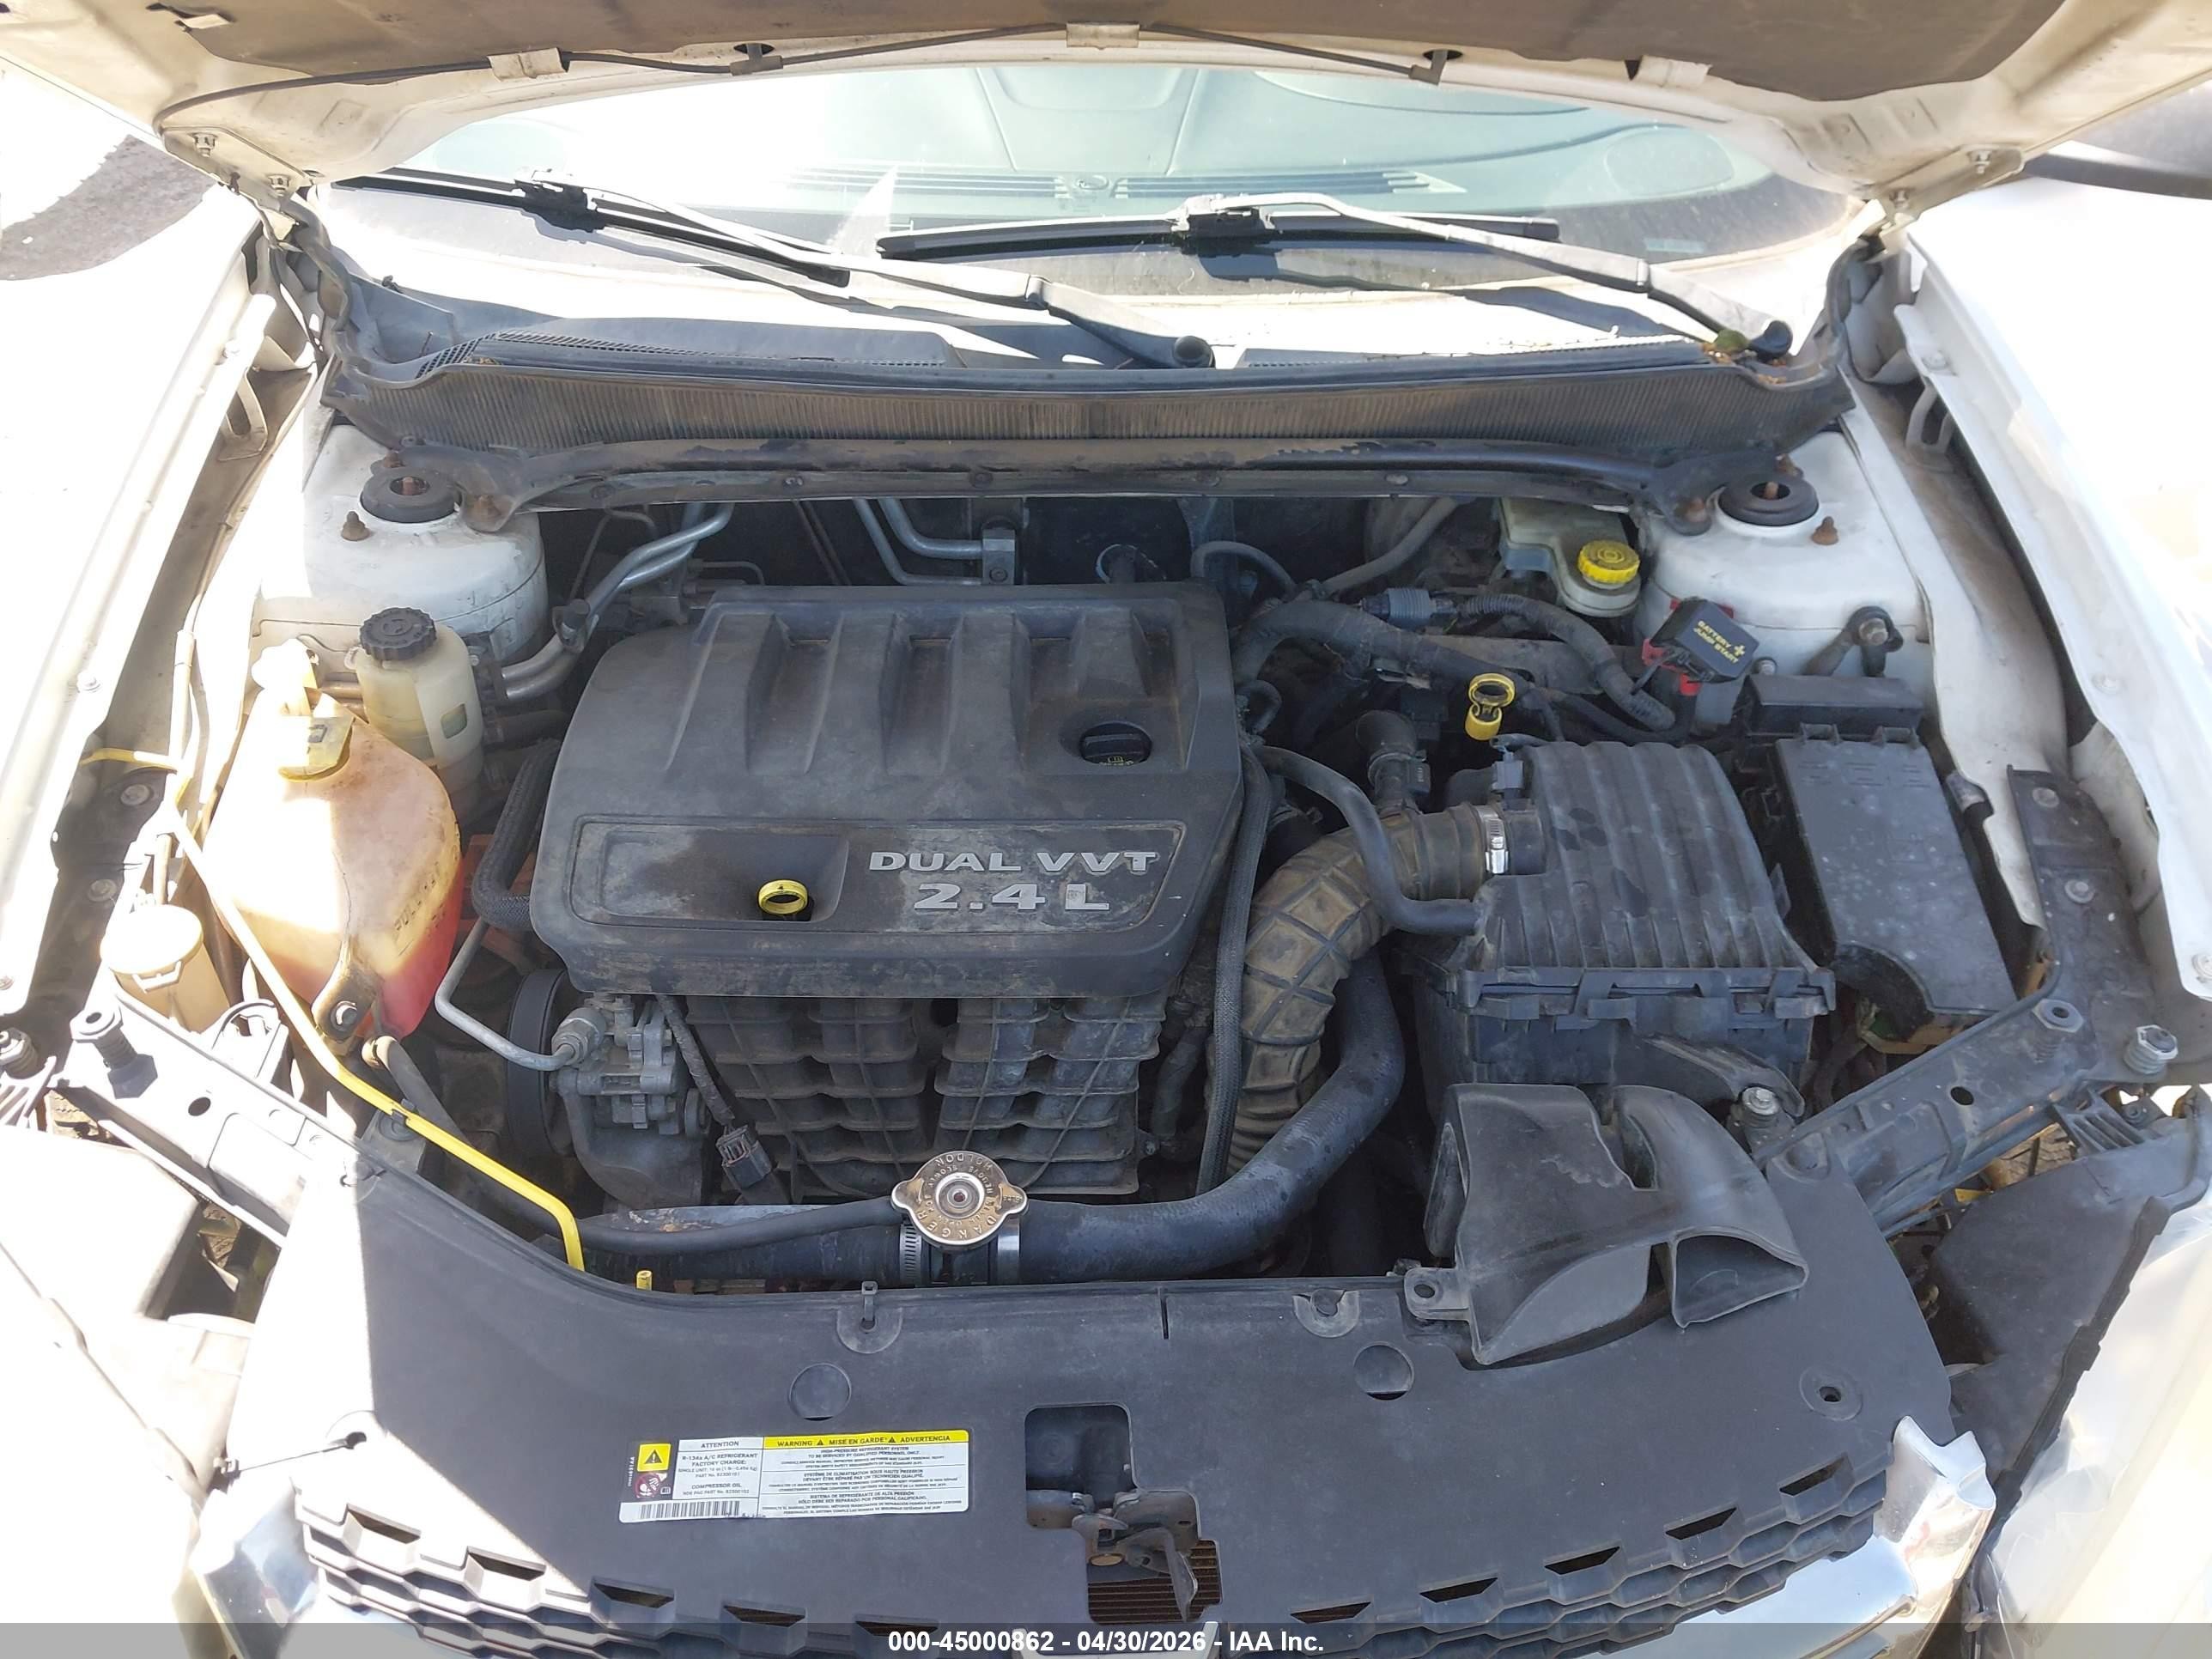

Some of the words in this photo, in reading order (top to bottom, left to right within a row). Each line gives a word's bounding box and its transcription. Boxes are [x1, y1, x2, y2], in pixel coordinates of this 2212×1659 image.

[1693, 627, 1716, 645] JUMP
[1714, 642, 1739, 664] START
[1698, 620, 1732, 647] BATTERY
[869, 852, 1022, 872] DUAL
[1036, 852, 1157, 872] VVT
[917, 1210, 997, 1239] DANGER
